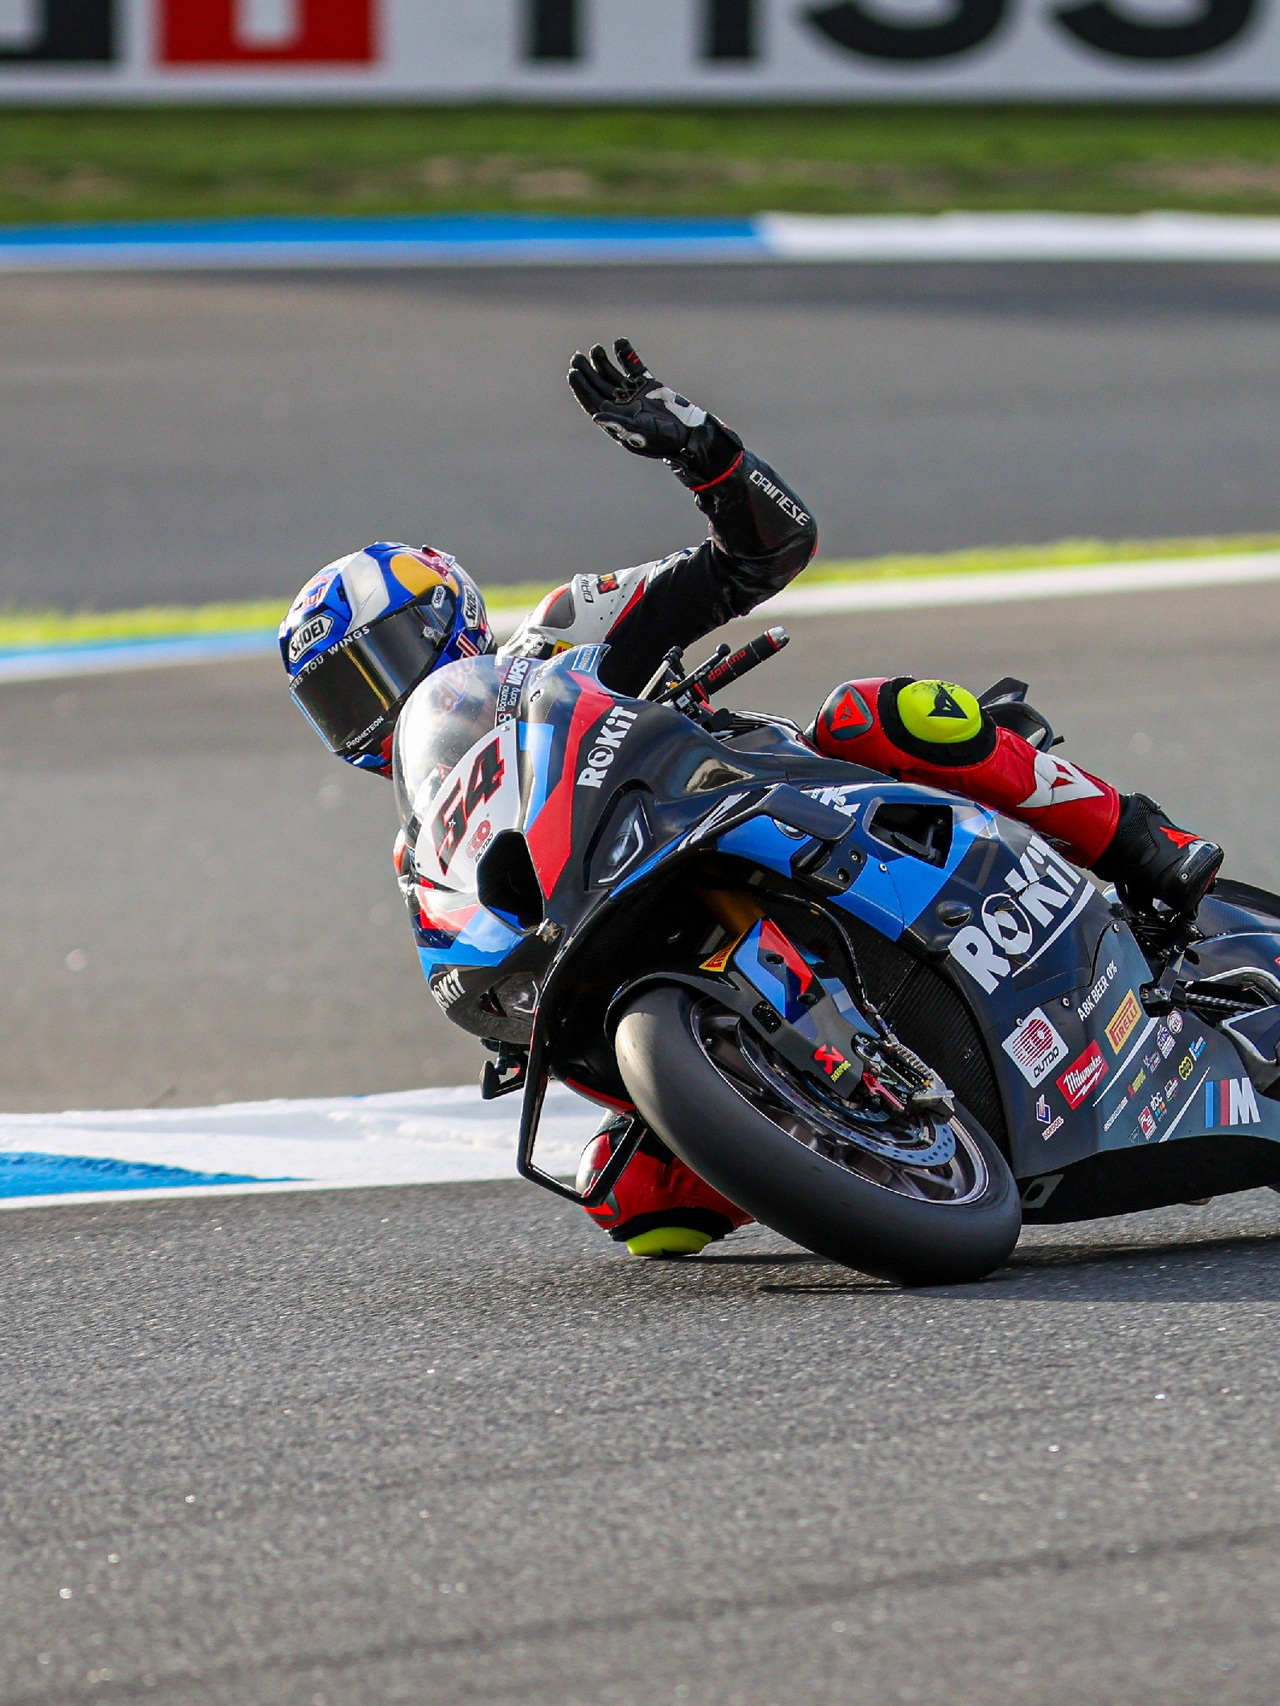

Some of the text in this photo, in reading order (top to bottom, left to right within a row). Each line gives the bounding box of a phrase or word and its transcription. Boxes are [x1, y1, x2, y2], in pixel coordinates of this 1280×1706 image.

[749, 469, 811, 527] DAINESE
[464, 590, 478, 625] SHOEI
[290, 620, 325, 658] SHOEI
[305, 655, 325, 675] YOU
[328, 626, 370, 656] WINGS
[505, 657, 530, 686] WRS
[708, 649, 747, 682] domino
[346, 716, 385, 750] PROMETEON
[431, 736, 505, 877] 54
[1077, 959, 1118, 1022] ABK BEER 0%
[1109, 997, 1140, 1047] PIRELLI
[1033, 1045, 1060, 1079] OUTDO
[1063, 1054, 1103, 1096] Milwaukee
